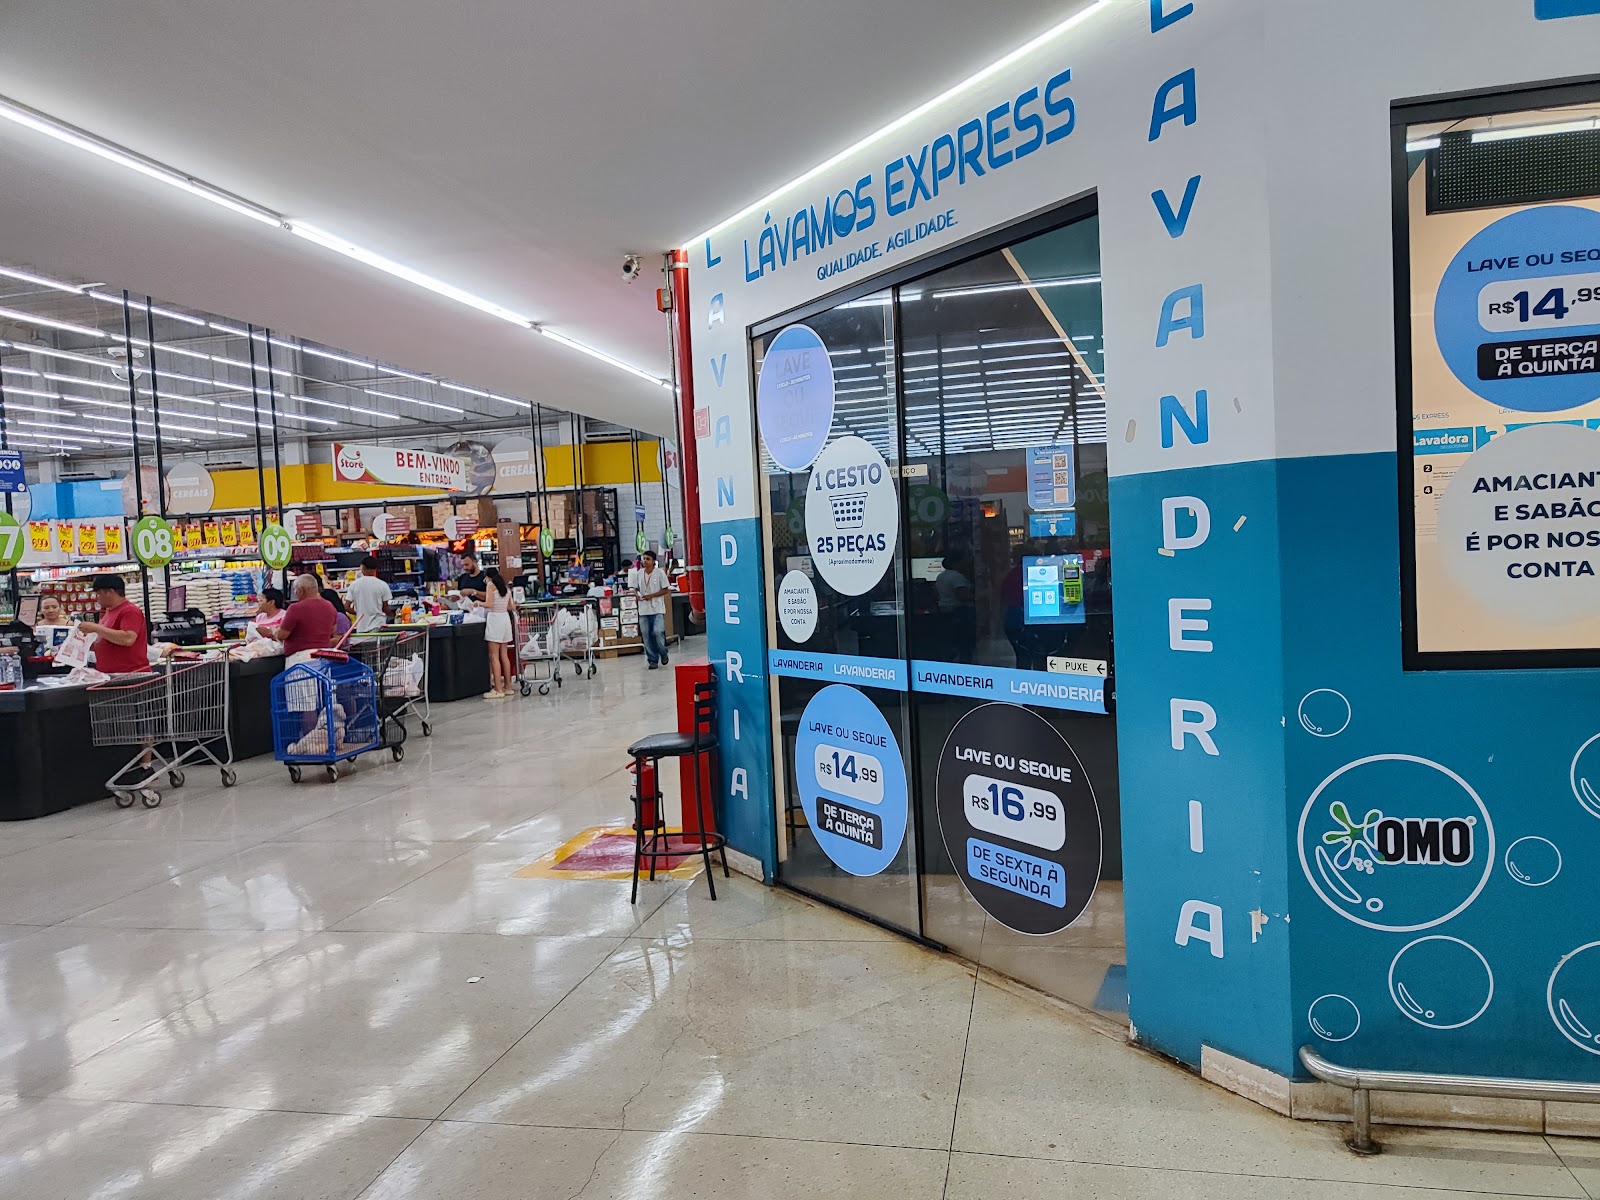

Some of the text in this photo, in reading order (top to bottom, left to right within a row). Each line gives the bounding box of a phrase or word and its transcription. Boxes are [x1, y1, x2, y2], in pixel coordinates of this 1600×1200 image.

[744, 68, 1076, 282] LÁVAMOS EXPRESS
[886, 208, 958, 253] AGILIDADE.
[1468, 256, 1519, 272] LAVE
[1525, 253, 1553, 267] OU
[1495, 340, 1598, 361] DE TERÇA
[1497, 356, 1595, 376] À QUINTA
[1422, 412, 1449, 420] EXPRESS
[1413, 433, 1469, 447] Lavadora
[340, 458, 364, 469] Store
[396, 451, 460, 475] BEM-VINDO
[419, 471, 452, 486] ENTRADA
[815, 462, 882, 491] 1 CESTO
[1472, 471, 1600, 494] AMACIAN
[172, 488, 209, 499] CEREAIS
[705, 237, 749, 800] LAVANDERIA
[1494, 505, 1509, 521] E
[137, 528, 173, 559] 08
[263, 535, 290, 561] 09
[541, 534, 553, 549] 10
[817, 533, 886, 557] 25 PEÇAS
[1466, 531, 1480, 551] É
[1487, 533, 1540, 551] POR
[1506, 560, 1595, 578] CONTA
[772, 657, 896, 681] LAVANDERIA LAVANDERIA
[1065, 661, 1088, 672] PUXE
[917, 671, 1104, 703] LAVANDERIA LAVANDERIA
[809, 720, 887, 748] LAVE OU SEQUE
[955, 746, 1072, 783] LAVE OU SEQUE
[823, 803, 874, 831] DE TERÇA
[825, 814, 874, 844] À QUINTA
[1377, 819, 1471, 863] OMO
[973, 845, 1058, 884] DE SEXTA À
[980, 864, 1052, 899] SEGUNDA
